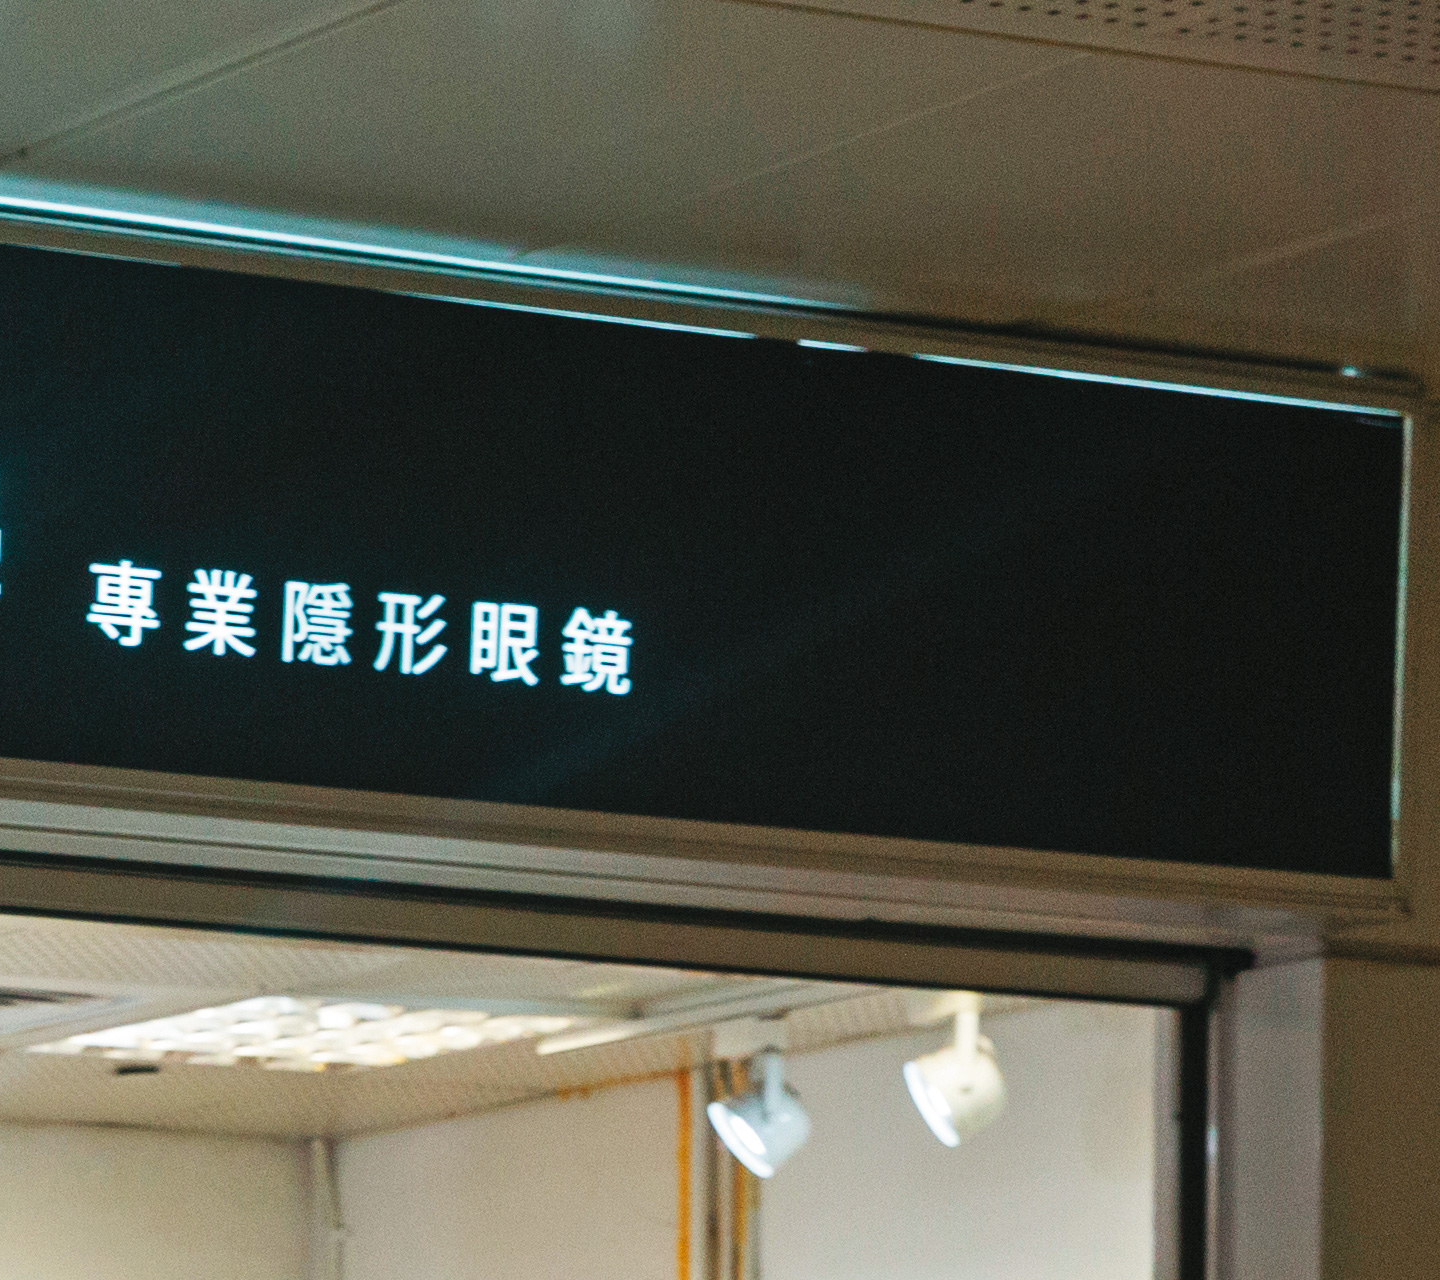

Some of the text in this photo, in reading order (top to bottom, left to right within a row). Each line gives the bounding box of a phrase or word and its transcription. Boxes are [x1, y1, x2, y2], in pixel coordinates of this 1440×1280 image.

[85, 559, 636, 698] 專業隱形眼鏡
